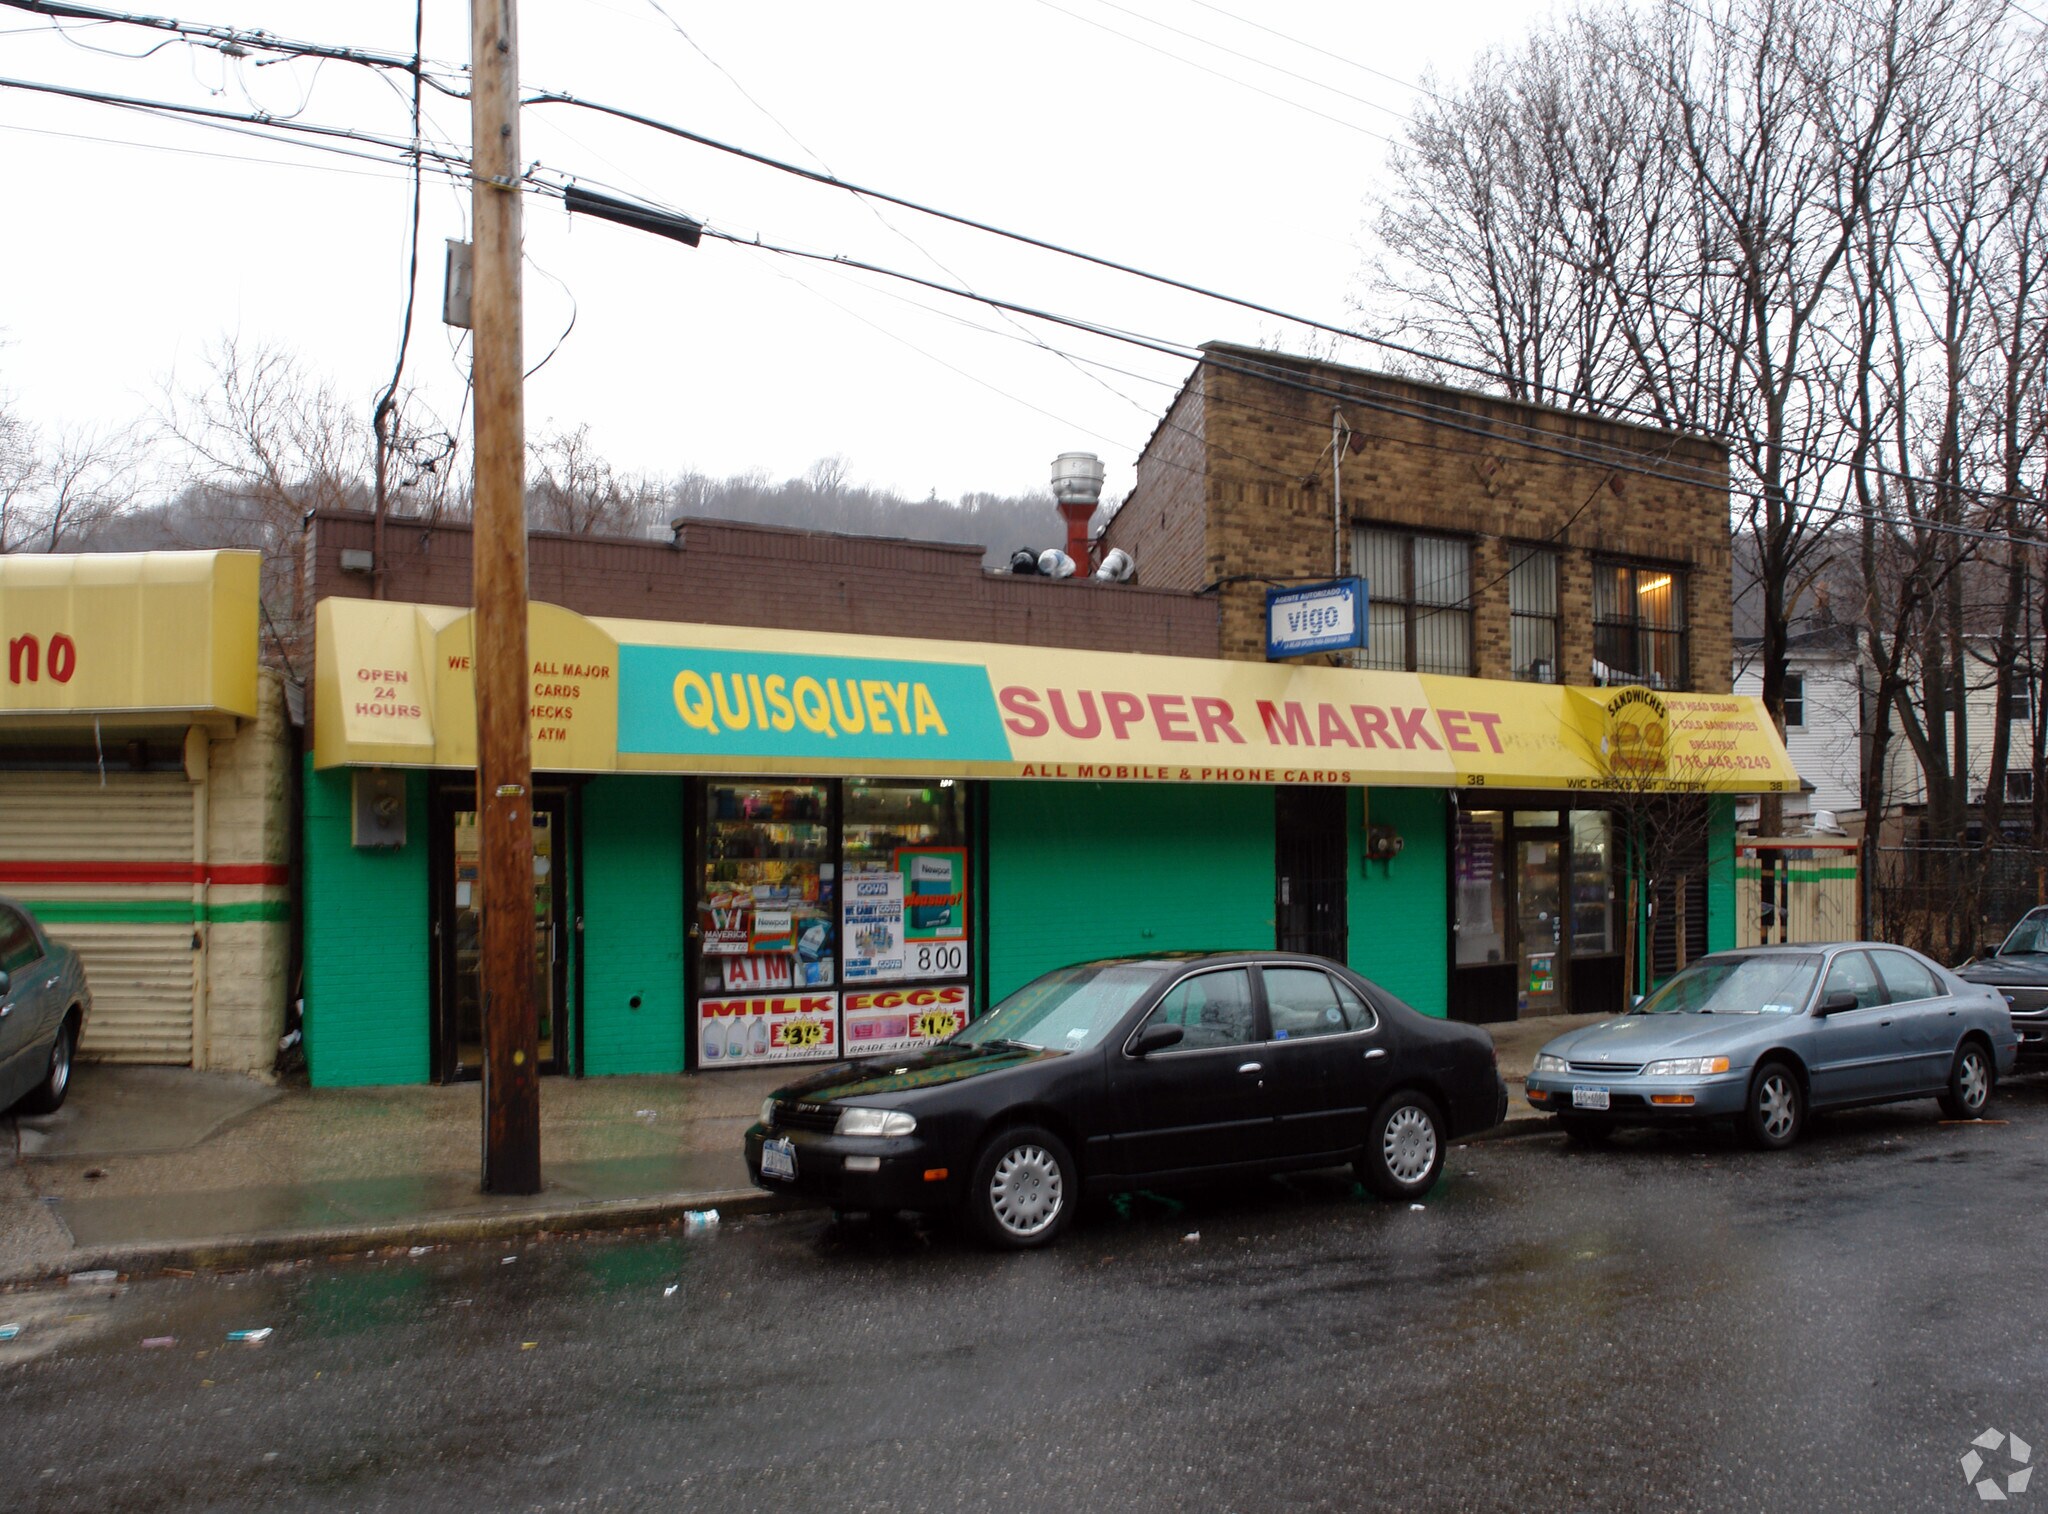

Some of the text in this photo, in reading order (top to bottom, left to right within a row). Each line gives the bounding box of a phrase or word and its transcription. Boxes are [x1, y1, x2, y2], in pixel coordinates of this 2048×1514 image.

[1300, 587, 1341, 600] AUTORIZADO
[1287, 602, 1339, 635] vigo
[448, 656, 610, 678] WE ALL MAJOR
[357, 668, 409, 684] OPEN
[374, 686, 397, 701] 24
[534, 683, 581, 698] CARDS
[355, 703, 422, 720] HOURS
[1607, 689, 1667, 719] SANDWICHES
[1686, 701, 1710, 711] HEAD
[1711, 703, 1740, 713] BRAND
[673, 669, 1506, 755] QUISQUEYA SUPER MARKET
[1680, 720, 1704, 730] COLD
[1704, 721, 1759, 732] SANDWICHES
[537, 728, 567, 741] ATM
[1688, 740, 1738, 750] BREAKFAST
[1674, 754, 1772, 770] 718-448-8249
[1022, 764, 1353, 784] ALL MOBILE & PHONE CARDS
[1466, 774, 1485, 787] 38
[1566, 779, 1588, 789] WIC
[1590, 780, 1633, 790] CHECKS
[1665, 781, 1706, 791] LOTTERY
[1769, 781, 1783, 792] 38
[922, 864, 951, 875] Newport
[757, 918, 789, 928] Newport
[704, 930, 748, 939] MAVERICK
[729, 955, 788, 983] ATM
[702, 995, 834, 1018] MILK
[846, 988, 966, 1011] EGGS
[850, 1044, 885, 1054] GRADE
